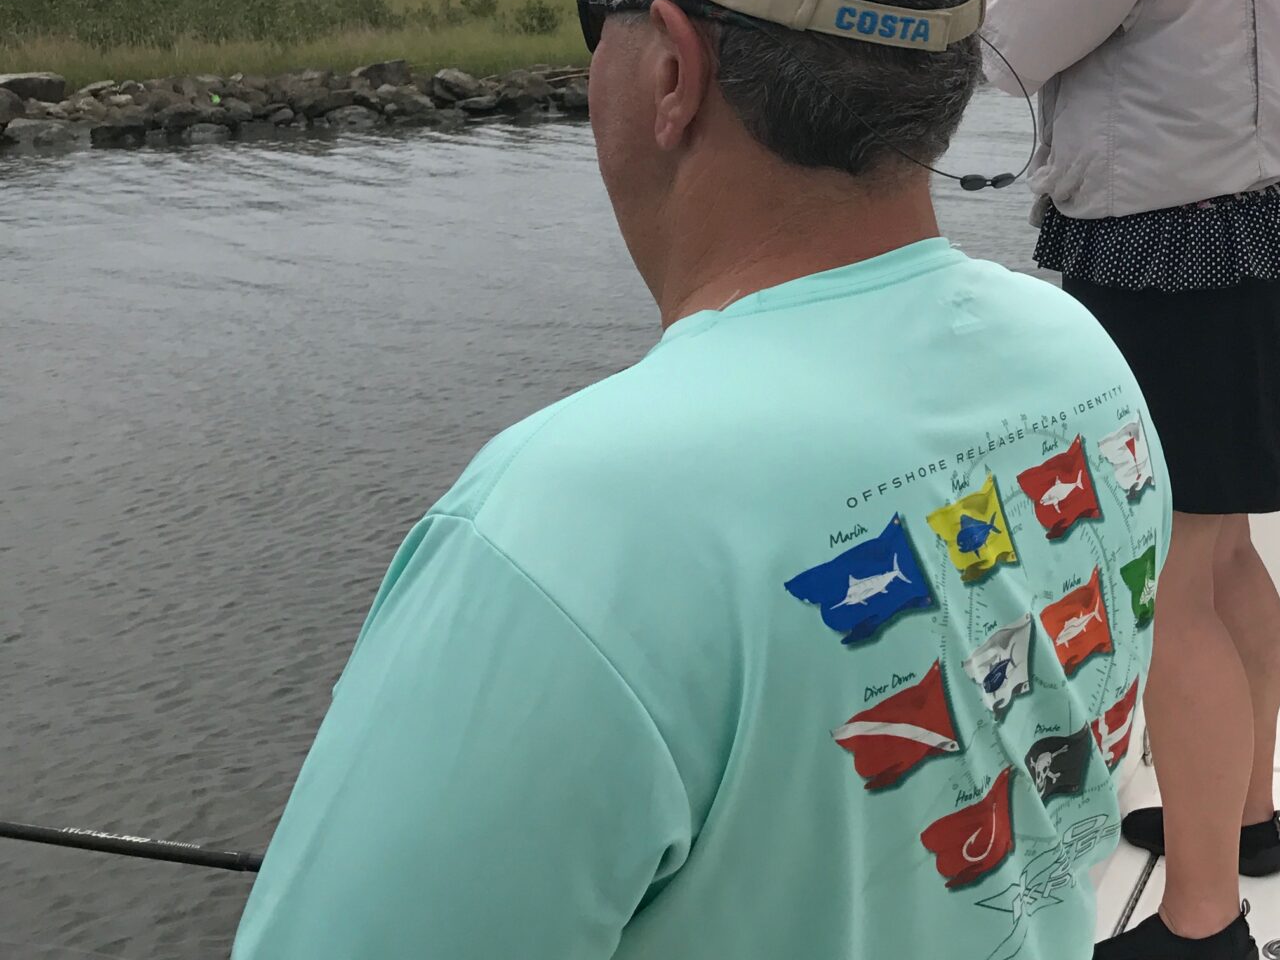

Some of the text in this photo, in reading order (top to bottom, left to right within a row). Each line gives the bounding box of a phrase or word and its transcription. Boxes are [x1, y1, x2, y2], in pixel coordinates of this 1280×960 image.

[835, 6, 930, 43] COSTA
[846, 459, 948, 509] OFFSHORE
[956, 428, 1025, 464] RELEASE
[1032, 411, 1067, 433] FLAG
[1073, 384, 1123, 415] IDENTITY
[1041, 438, 1060, 456] Shark
[829, 523, 868, 549] Marlin
[864, 671, 917, 702] Diver Down
[1033, 722, 1061, 738] Pirate
